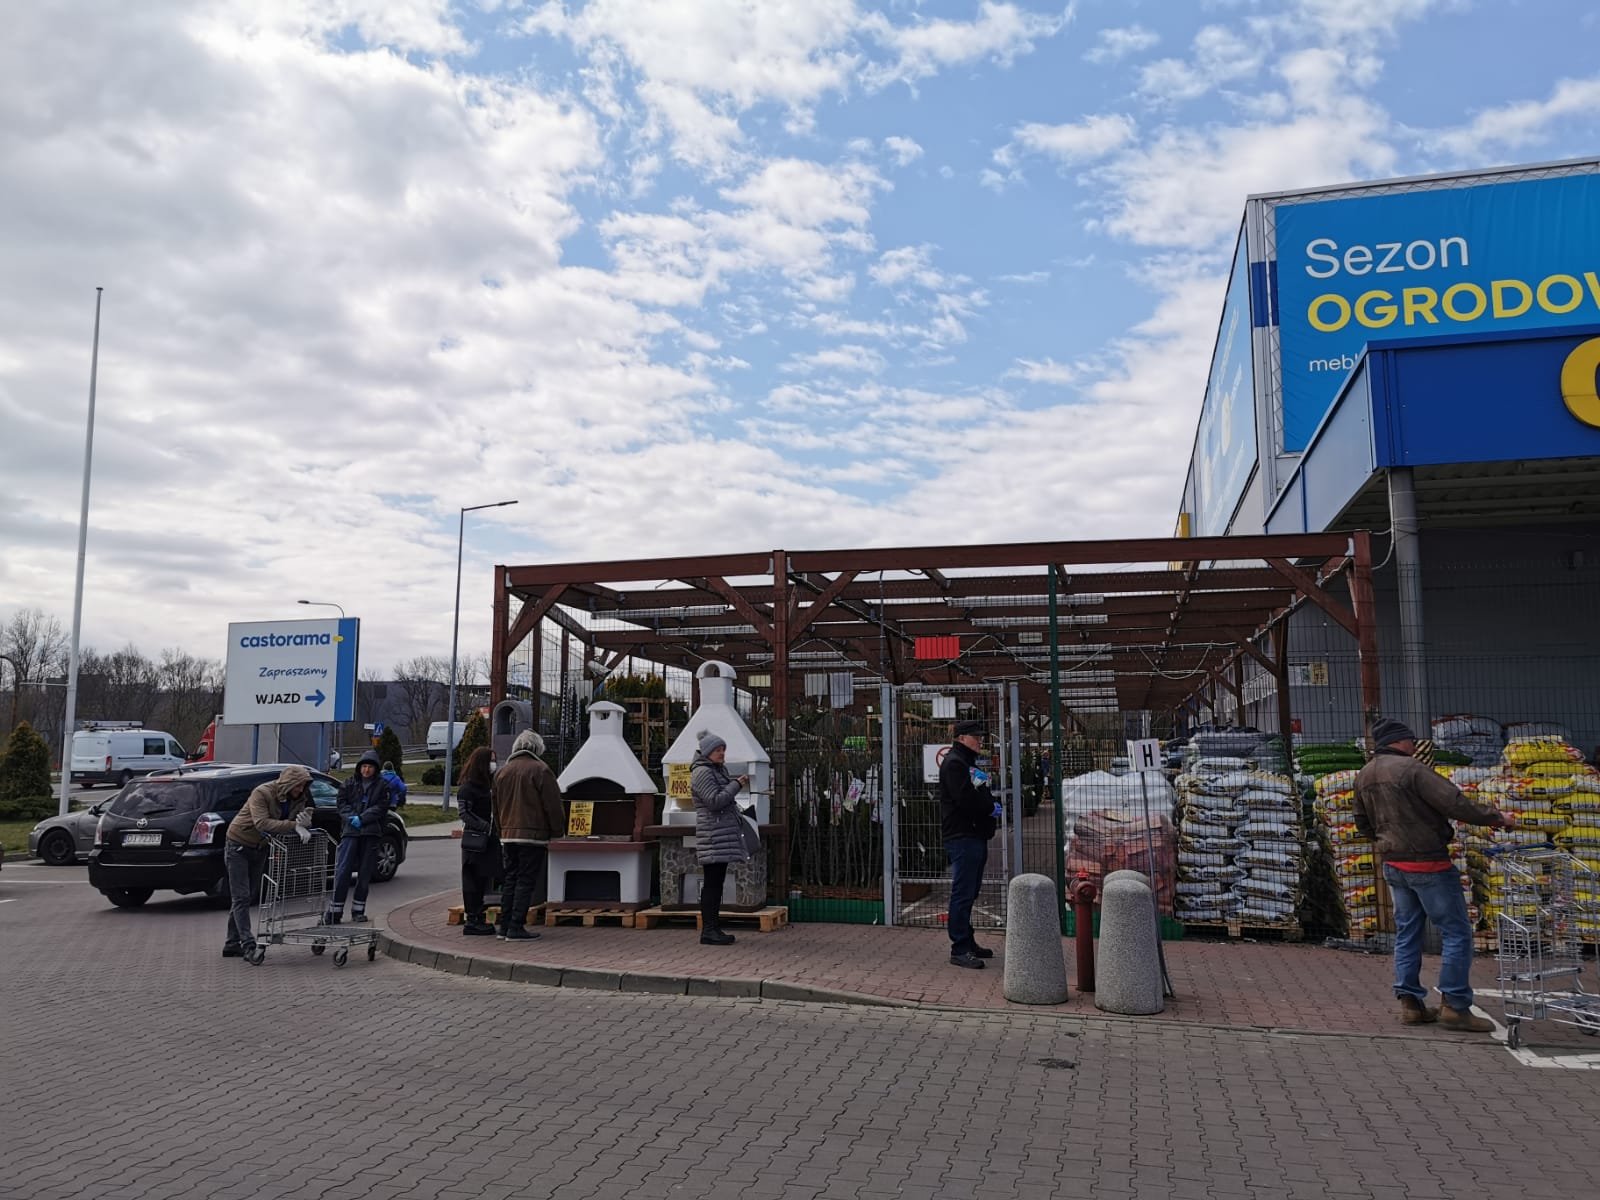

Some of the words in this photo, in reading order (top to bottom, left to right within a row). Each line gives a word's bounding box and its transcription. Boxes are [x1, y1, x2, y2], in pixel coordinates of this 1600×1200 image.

[1305, 236, 1469, 278] Sezon
[1307, 271, 1600, 332] OGRODO
[240, 633, 331, 648] castorama
[259, 666, 328, 680] Zapraszamy
[255, 693, 301, 704] WJAZD
[1142, 744, 1154, 767] H
